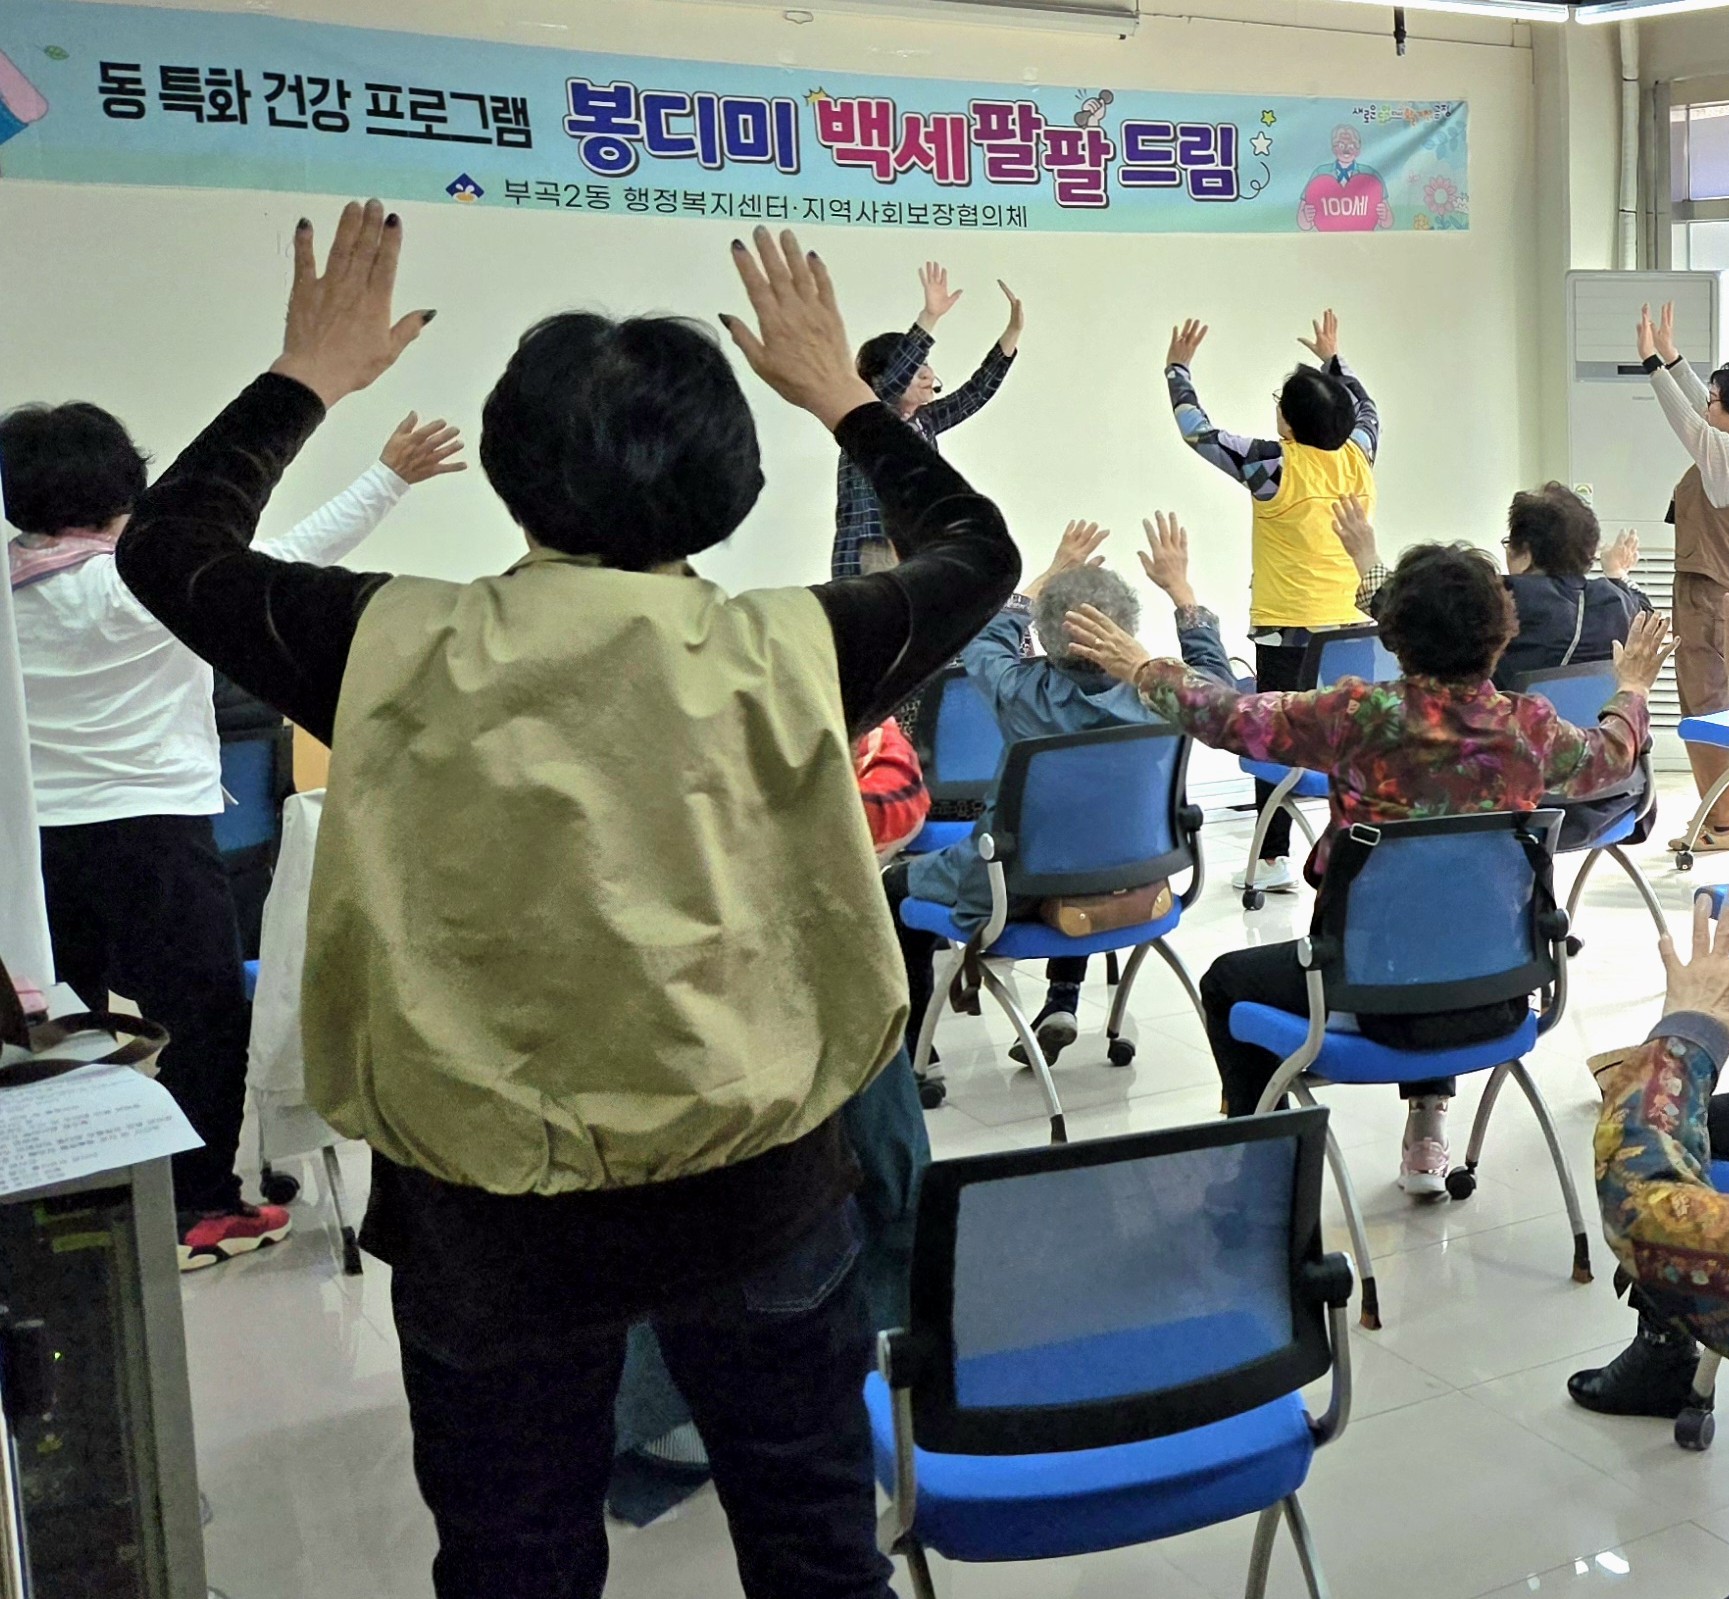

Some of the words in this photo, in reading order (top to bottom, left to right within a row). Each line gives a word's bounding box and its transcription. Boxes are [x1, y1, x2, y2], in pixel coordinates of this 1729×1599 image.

[98, 61, 146, 120] 동
[158, 65, 252, 125] 특화
[262, 71, 352, 133] 건강
[364, 82, 533, 149] 프로그램
[564, 77, 800, 177] 봉디미
[815, 97, 1115, 208] 백세팔팔
[1118, 119, 1239, 202] 드림
[504, 178, 611, 210] 부곡2동
[1320, 195, 1369, 217] 100세
